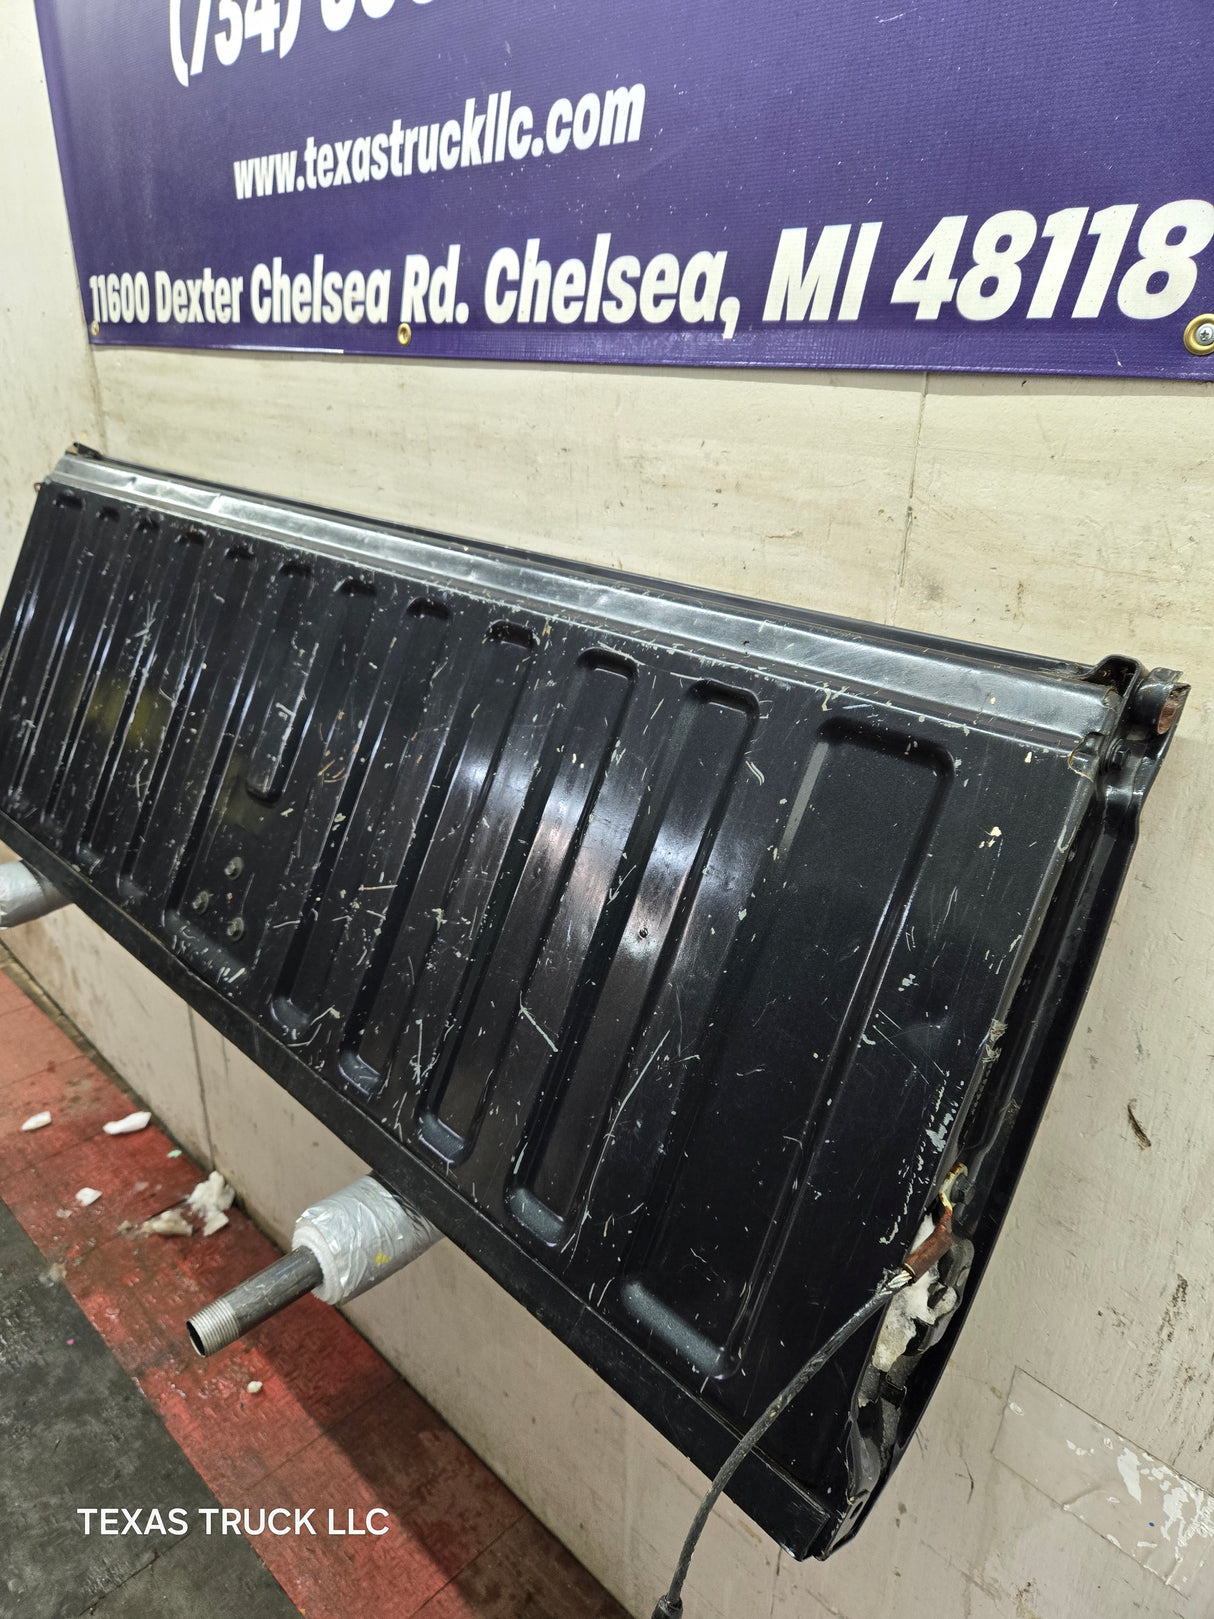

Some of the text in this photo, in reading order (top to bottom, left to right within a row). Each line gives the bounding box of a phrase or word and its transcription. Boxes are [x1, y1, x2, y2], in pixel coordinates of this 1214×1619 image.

[233, 83, 646, 200] www.texastruckllc.com
[89, 199, 1214, 340] 11600 Dexter Chelsea Rd. Chelsea, MI 48118
